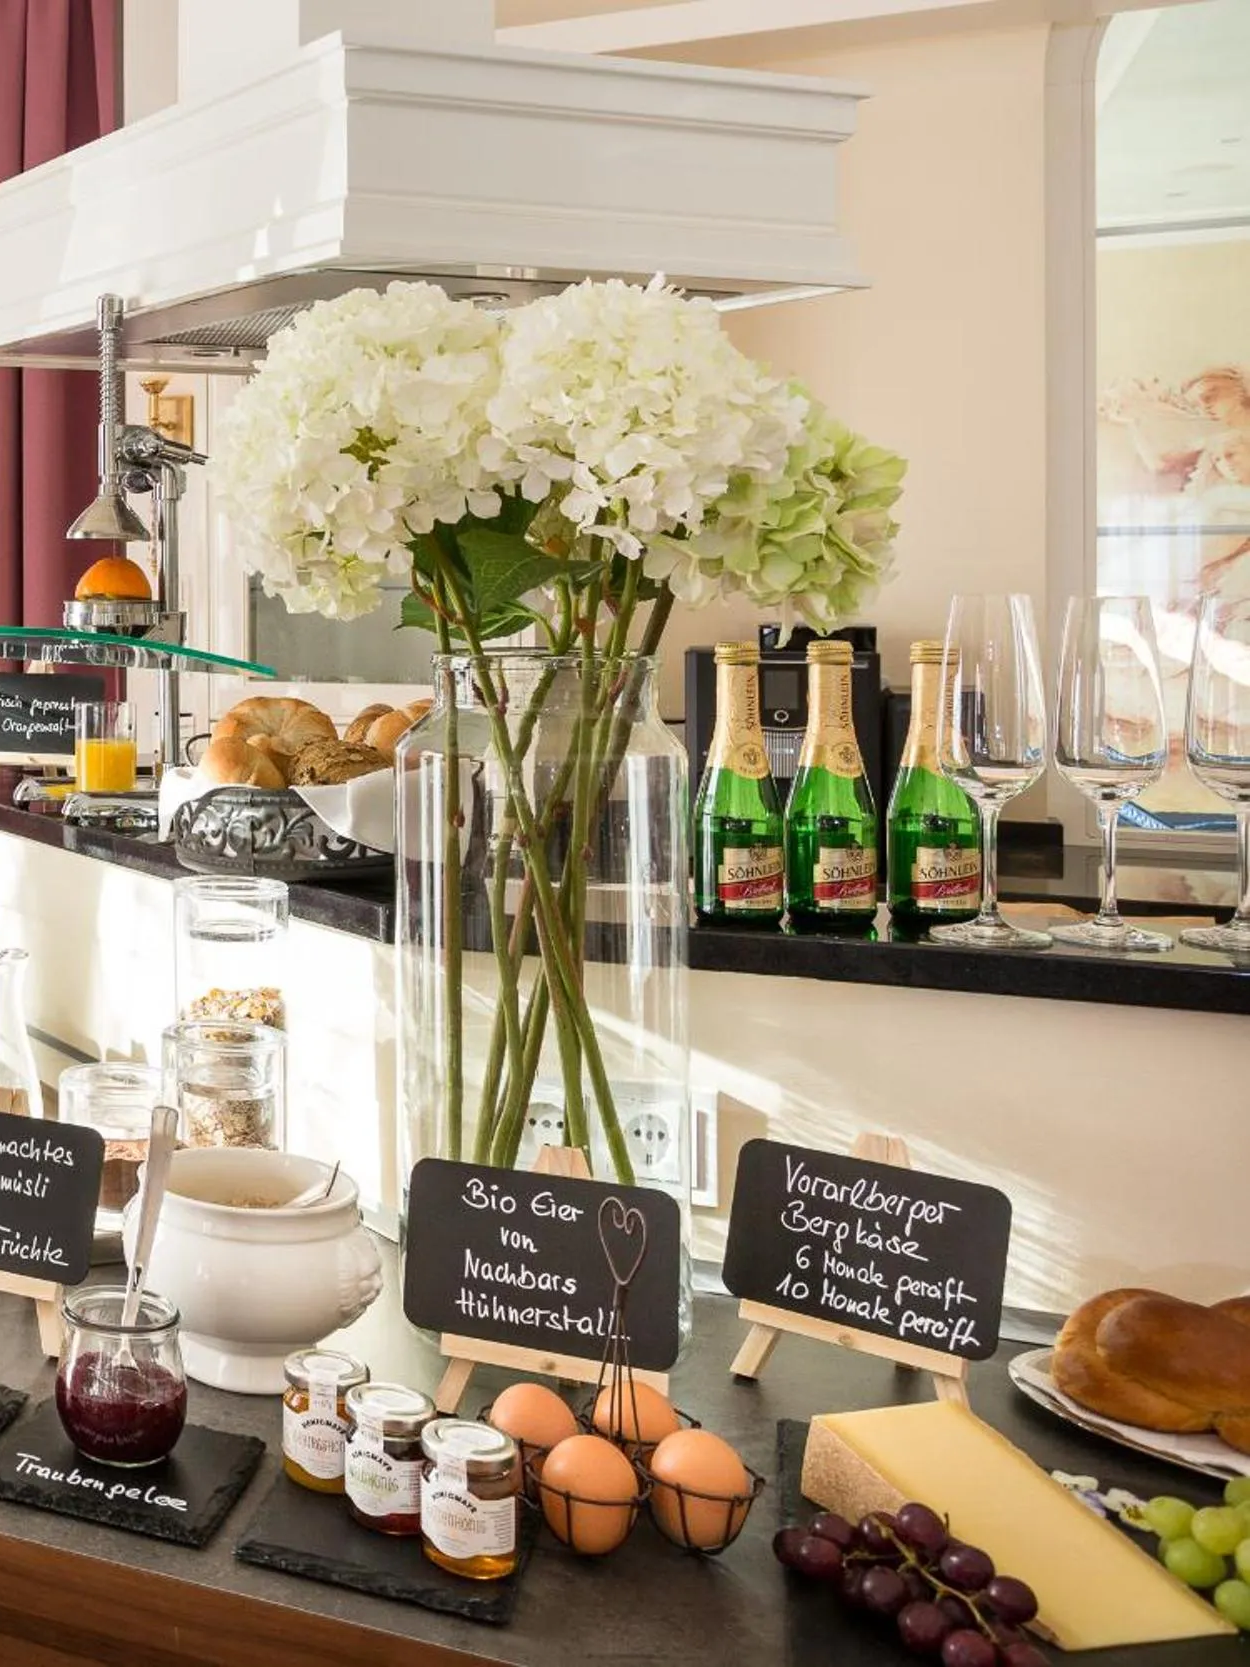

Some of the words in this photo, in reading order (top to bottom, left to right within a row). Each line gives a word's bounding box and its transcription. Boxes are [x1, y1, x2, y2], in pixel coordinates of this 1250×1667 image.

[1, 717, 78, 740] Orangensaft
[462, 1178, 517, 1214] Bio
[531, 1191, 584, 1222] Eier
[785, 1154, 961, 1237] Vorarlberger
[500, 1226, 538, 1254] von
[463, 1248, 578, 1295] Nachbars
[795, 1244, 811, 1270] 6
[822, 1250, 889, 1288] Monate
[895, 1277, 978, 1311] gereift
[776, 1273, 809, 1299] 10
[820, 1278, 894, 1325] Monate
[899, 1309, 981, 1350] gereift
